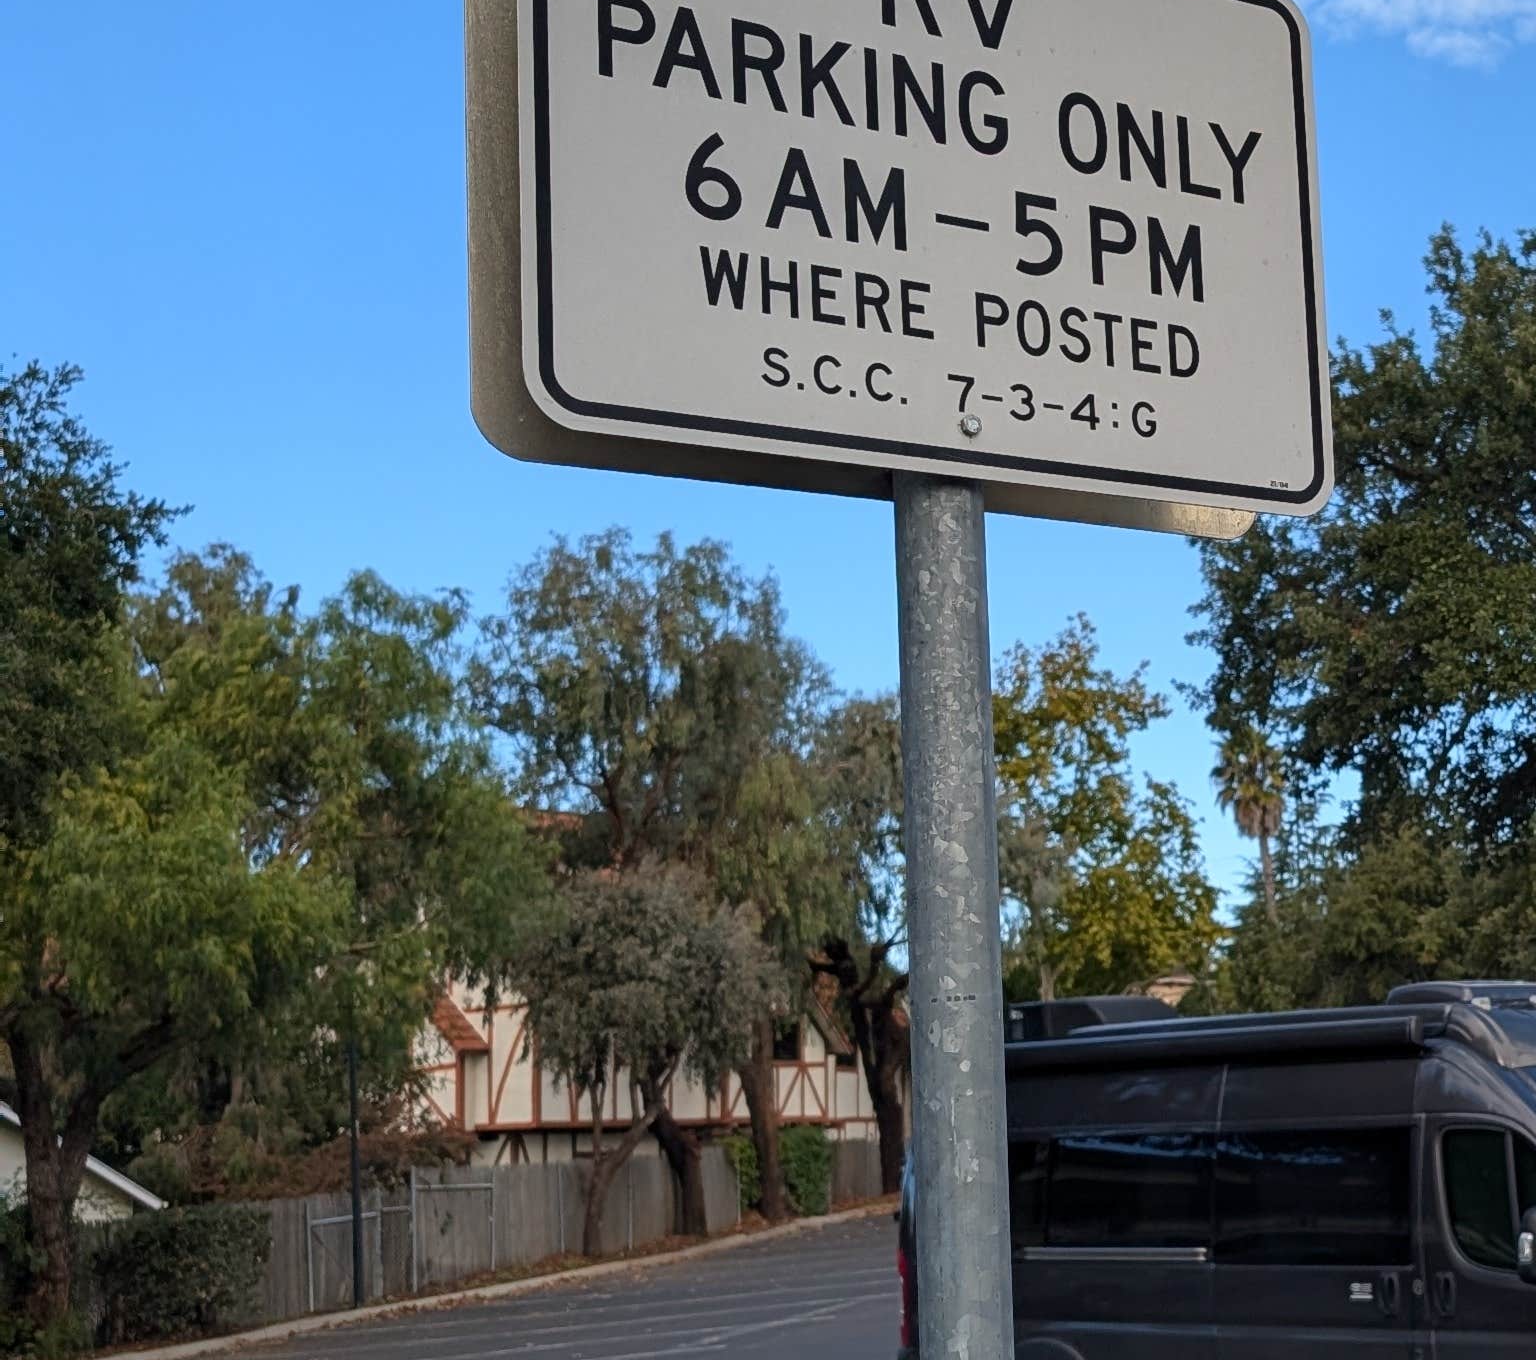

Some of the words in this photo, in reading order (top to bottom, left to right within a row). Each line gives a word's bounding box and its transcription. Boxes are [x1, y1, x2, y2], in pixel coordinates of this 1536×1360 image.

[1058, 92, 1262, 204] ONLY
[699, 245, 935, 340] WHERE
[976, 291, 1200, 378] POSTED
[761, 347, 908, 405] S.C.C.
[947, 373, 1157, 438] 7-3-4:G
